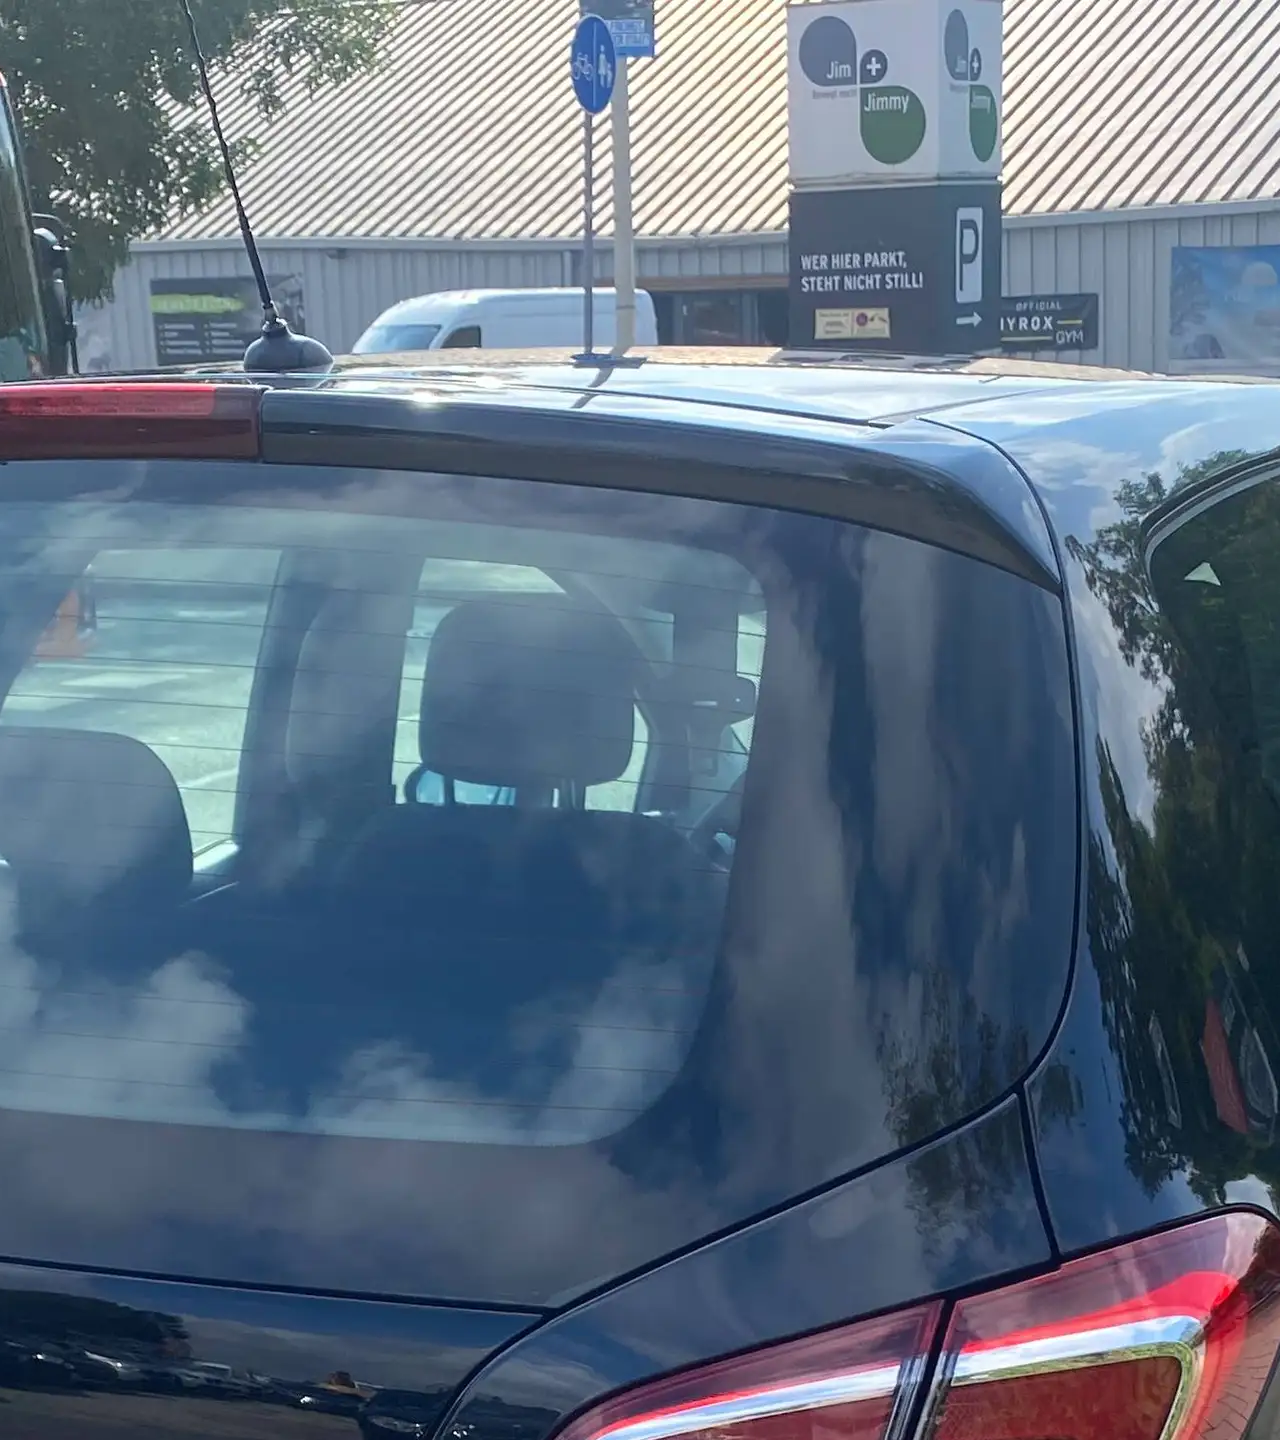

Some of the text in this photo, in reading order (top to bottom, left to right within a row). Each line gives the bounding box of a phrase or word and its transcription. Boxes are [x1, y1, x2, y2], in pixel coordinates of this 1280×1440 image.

[826, 61, 852, 80] Jim
[864, 93, 910, 114] Jimmy
[800, 251, 908, 271] WER HIER PARKT,
[959, 219, 979, 292] P
[800, 272, 924, 292] STEHT NICHT STILL!
[1015, 301, 1062, 312] OFFICIAL
[1055, 330, 1084, 344] GYM
